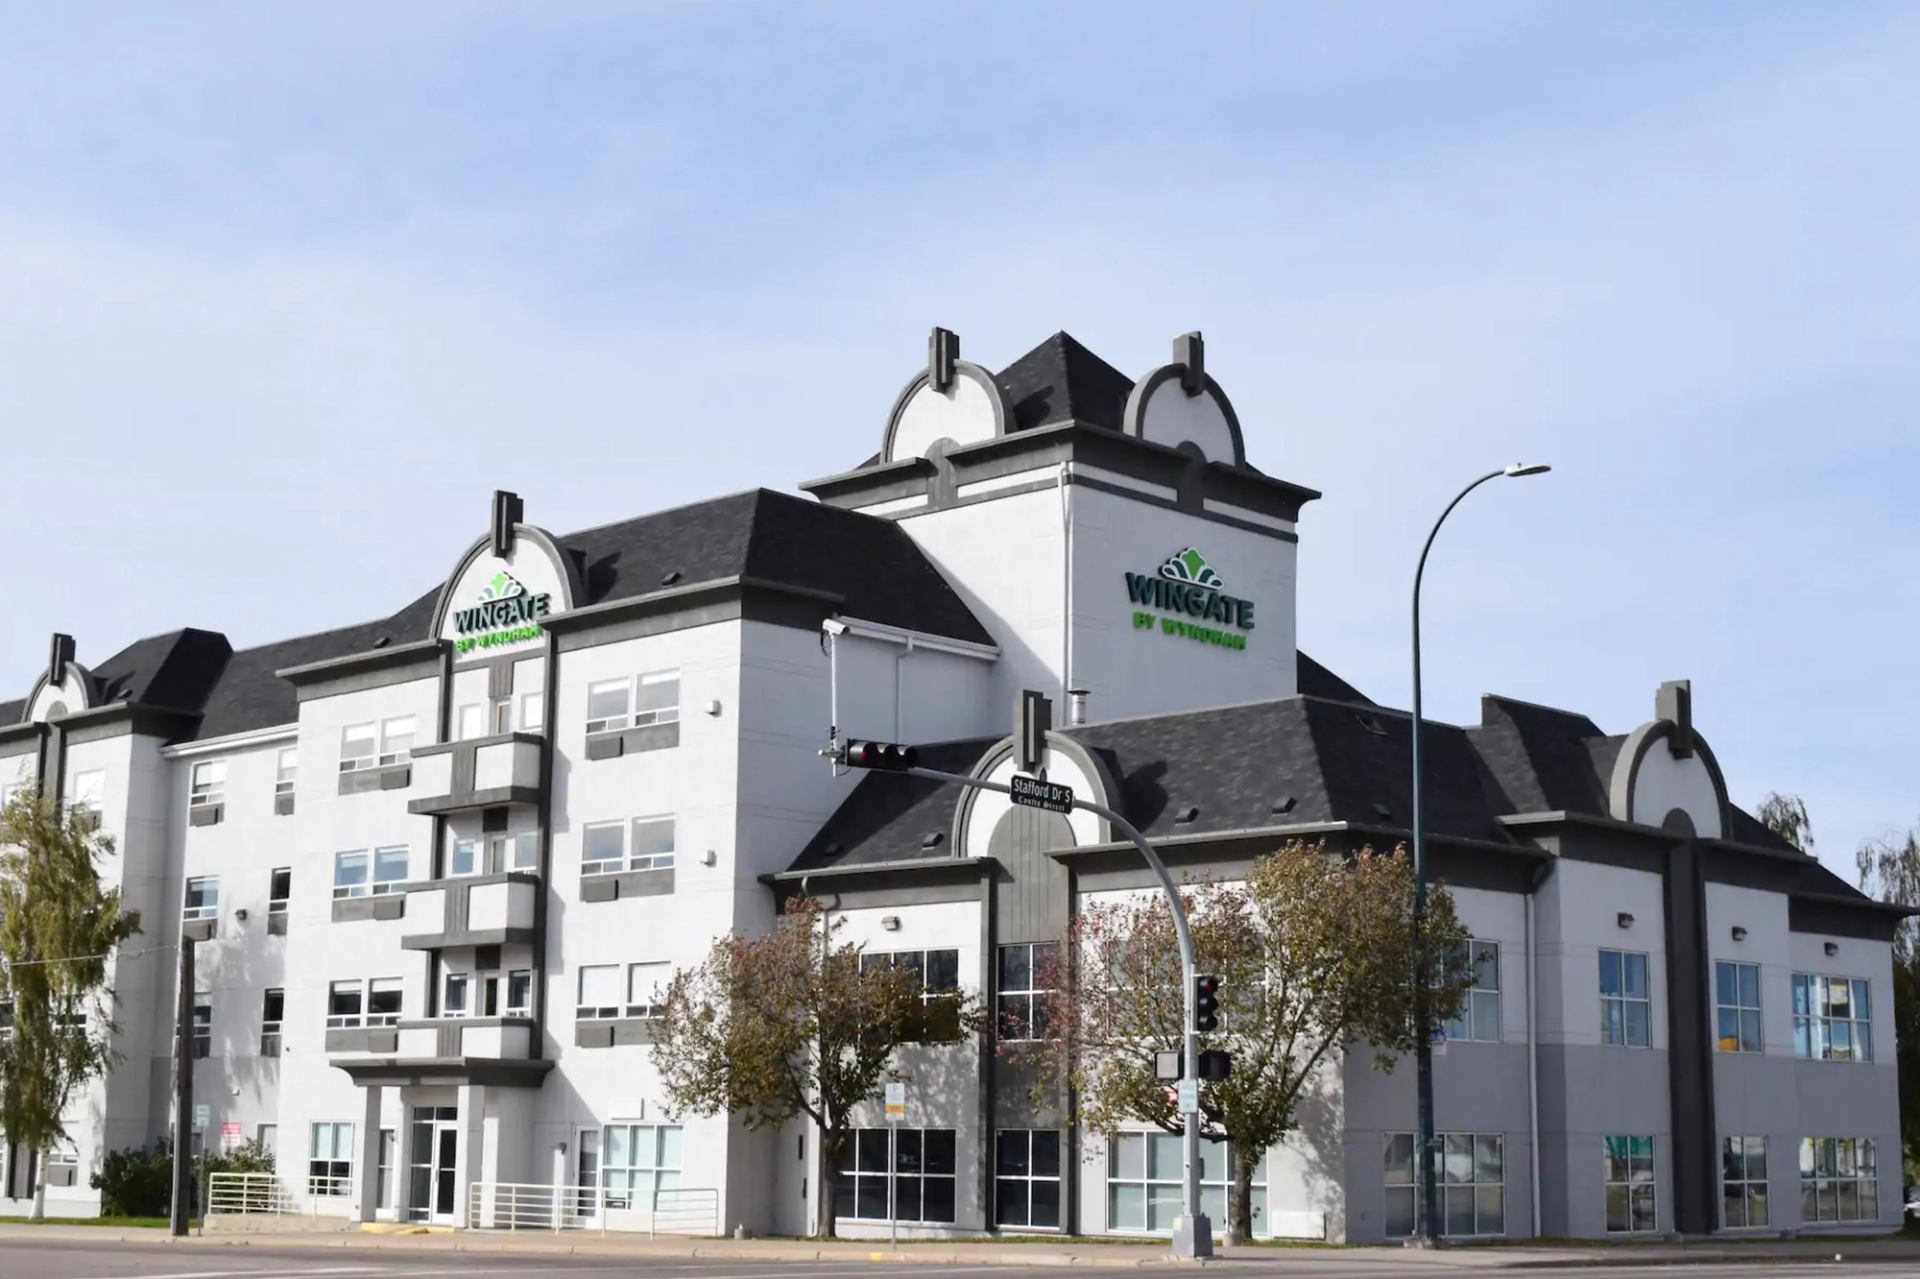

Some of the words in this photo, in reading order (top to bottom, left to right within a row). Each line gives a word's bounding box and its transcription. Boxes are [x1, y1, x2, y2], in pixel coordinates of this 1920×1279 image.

[453, 593, 551, 633] WINGATE
[1125, 571, 1255, 630] WINGATE
[455, 638, 476, 654] BY
[477, 623, 544, 649] WYNDHAM
[1132, 611, 1156, 630] BY
[1161, 617, 1247, 651] WYNDHAM
[1014, 778, 1049, 799] Stafford
[1052, 786, 1062, 801] Dr
[1064, 789, 1071, 803] S
